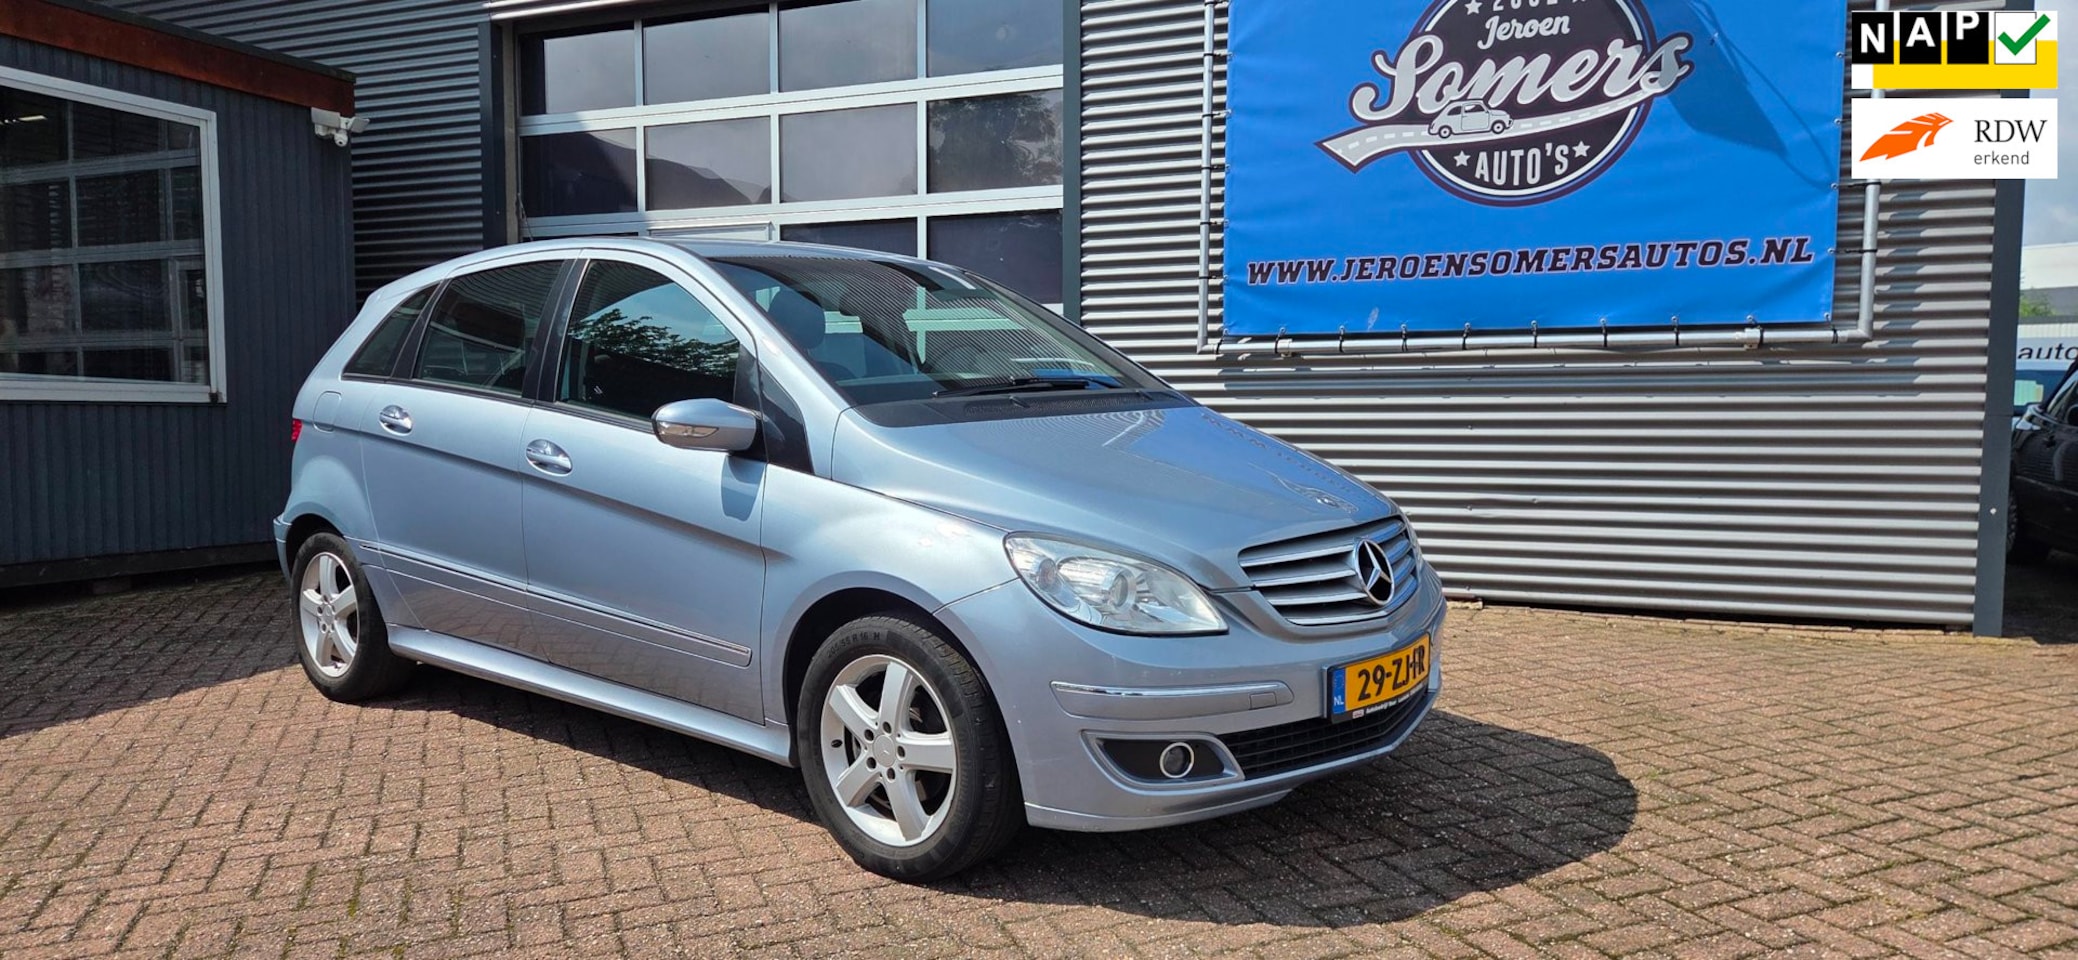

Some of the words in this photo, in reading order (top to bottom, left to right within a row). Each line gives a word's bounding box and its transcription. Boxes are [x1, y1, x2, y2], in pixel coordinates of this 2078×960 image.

[1477, 15, 1570, 50] Jeroen
[1352, 34, 1690, 121] Somers
[1475, 143, 1569, 187] AUTO'S
[1246, 235, 1814, 286] WWW.JEROENSOMERSAUTOS.NL
[1333, 695, 1344, 706] NL
